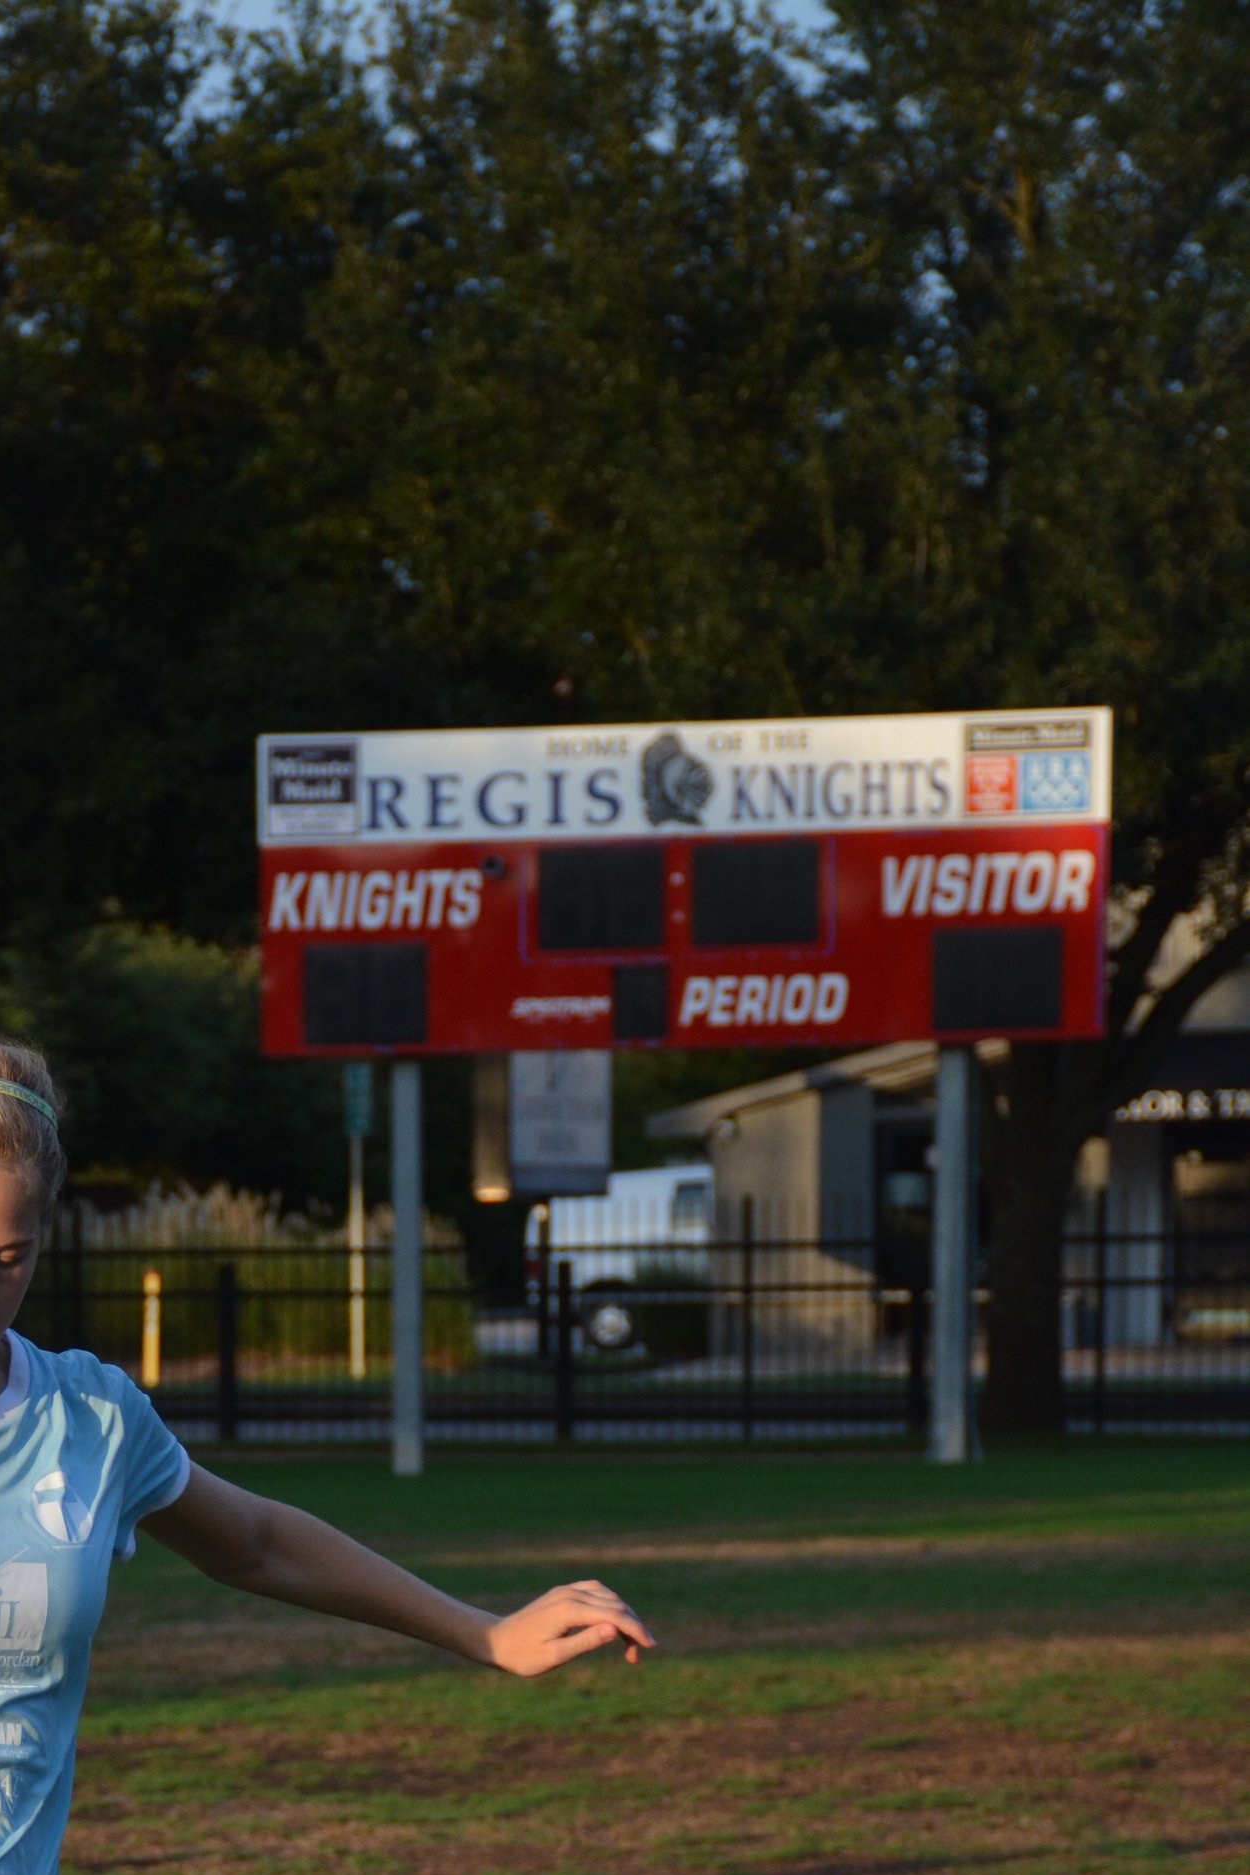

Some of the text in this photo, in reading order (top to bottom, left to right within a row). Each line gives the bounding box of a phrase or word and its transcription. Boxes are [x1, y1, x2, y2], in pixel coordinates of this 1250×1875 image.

[547, 728, 810, 759] HOME OF THE
[364, 768, 623, 830] REGIS
[730, 758, 951, 822] KNIGHTS
[268, 868, 483, 931] KNIGHTS
[882, 850, 1096, 917] VISITOR
[679, 972, 849, 1027] PERIOD
